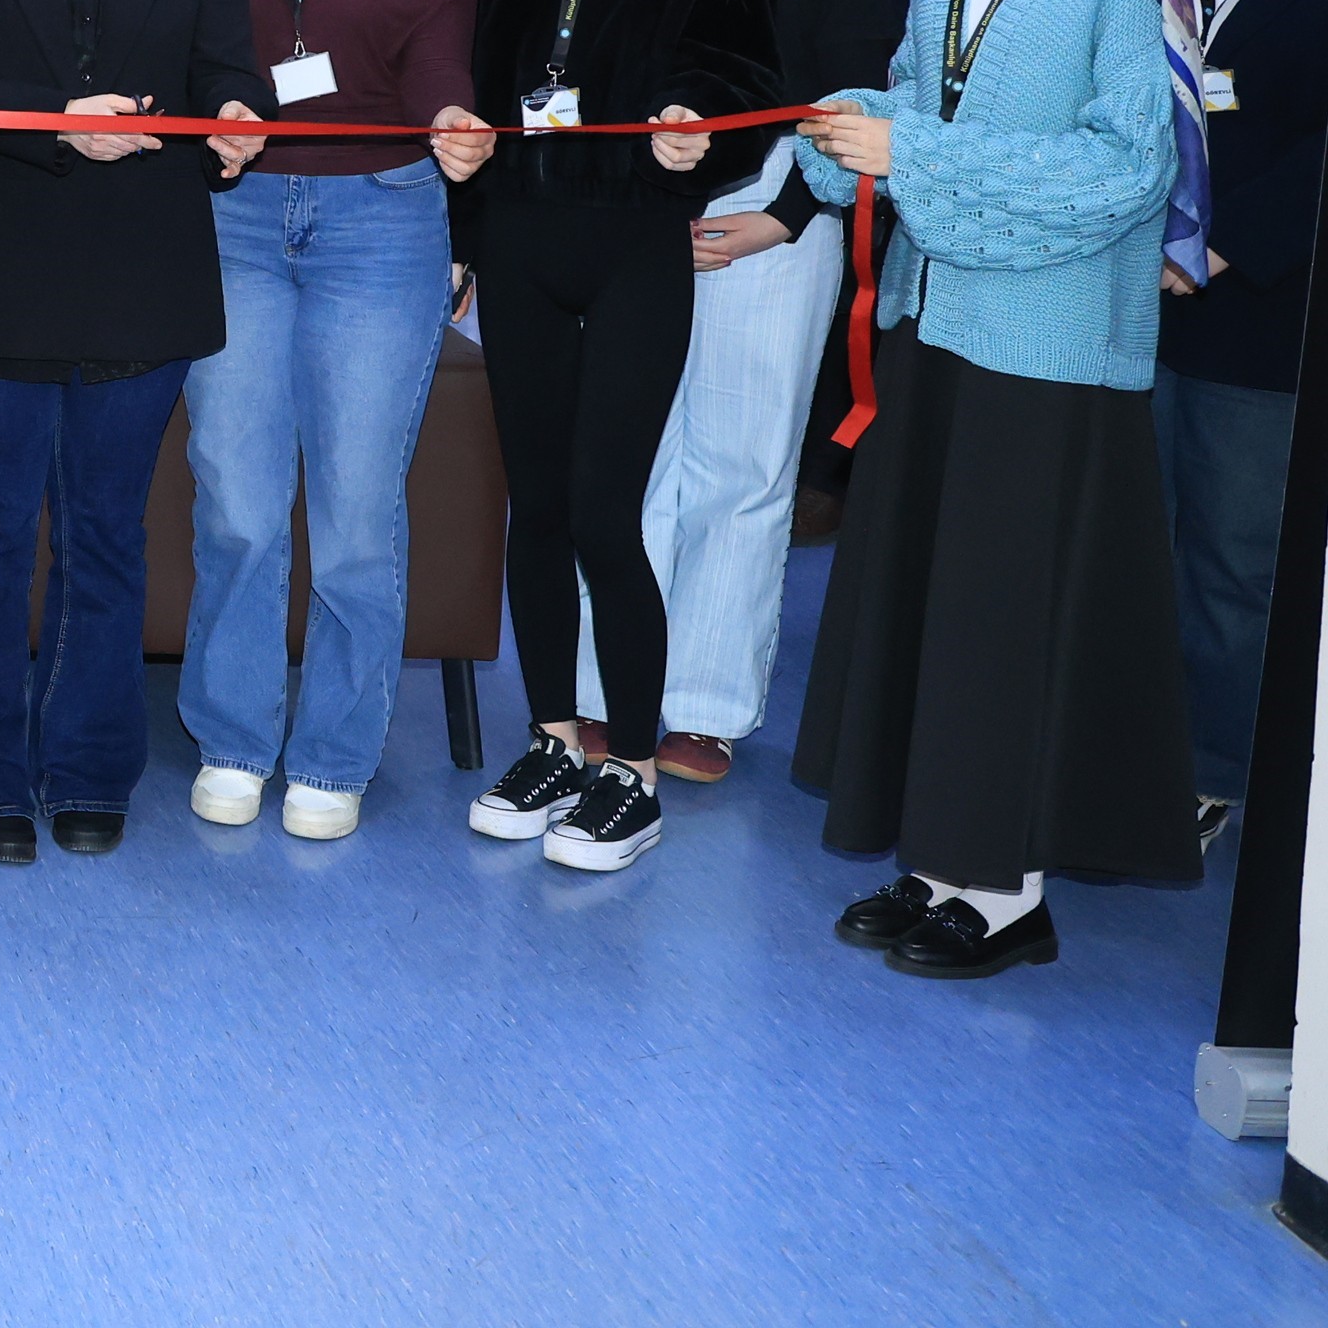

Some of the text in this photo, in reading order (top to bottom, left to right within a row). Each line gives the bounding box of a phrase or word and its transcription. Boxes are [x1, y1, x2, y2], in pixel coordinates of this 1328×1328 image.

[951, 10, 959, 30] Daire
[947, 30, 957, 68] Başkanlığı
[960, 37, 981, 73] Kütüphane
